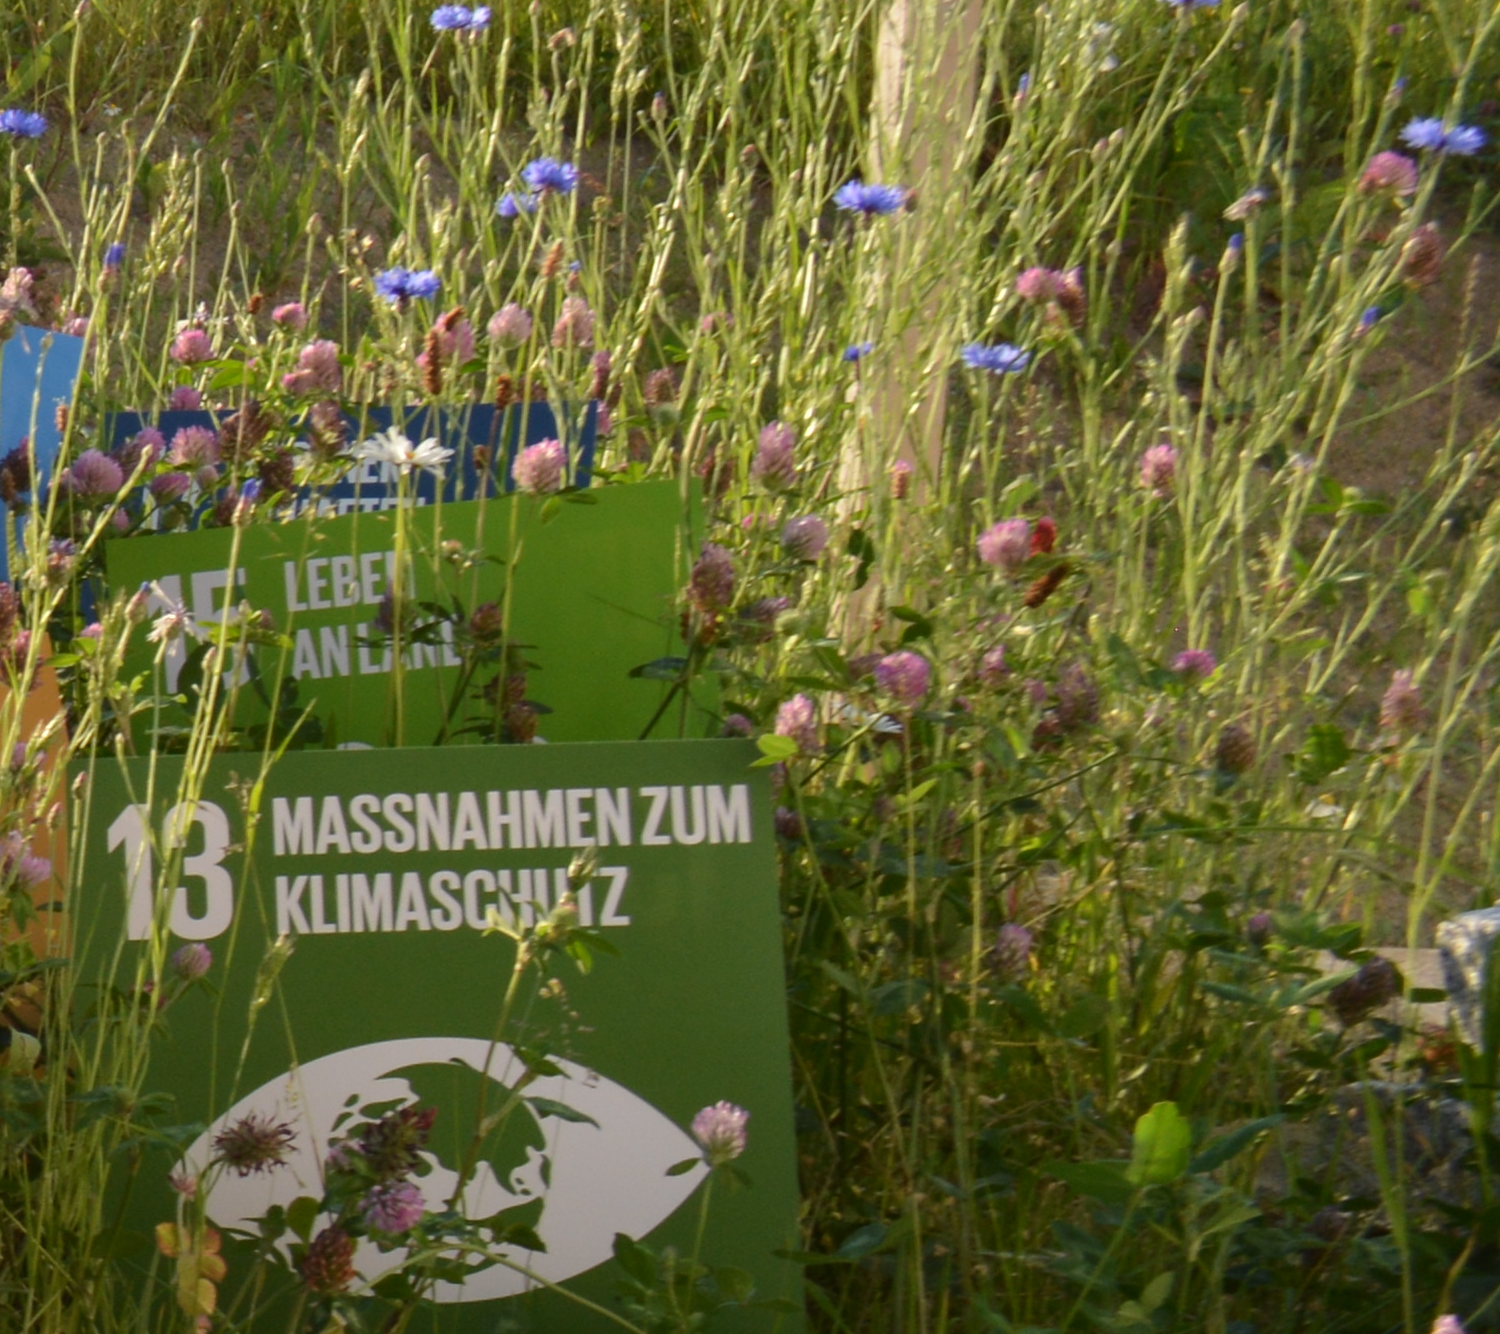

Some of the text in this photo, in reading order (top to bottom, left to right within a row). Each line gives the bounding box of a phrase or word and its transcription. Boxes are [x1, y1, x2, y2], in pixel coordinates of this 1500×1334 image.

[291, 624, 351, 680] AN
[107, 783, 752, 942] 13 MASSNAHMEN ZUM
